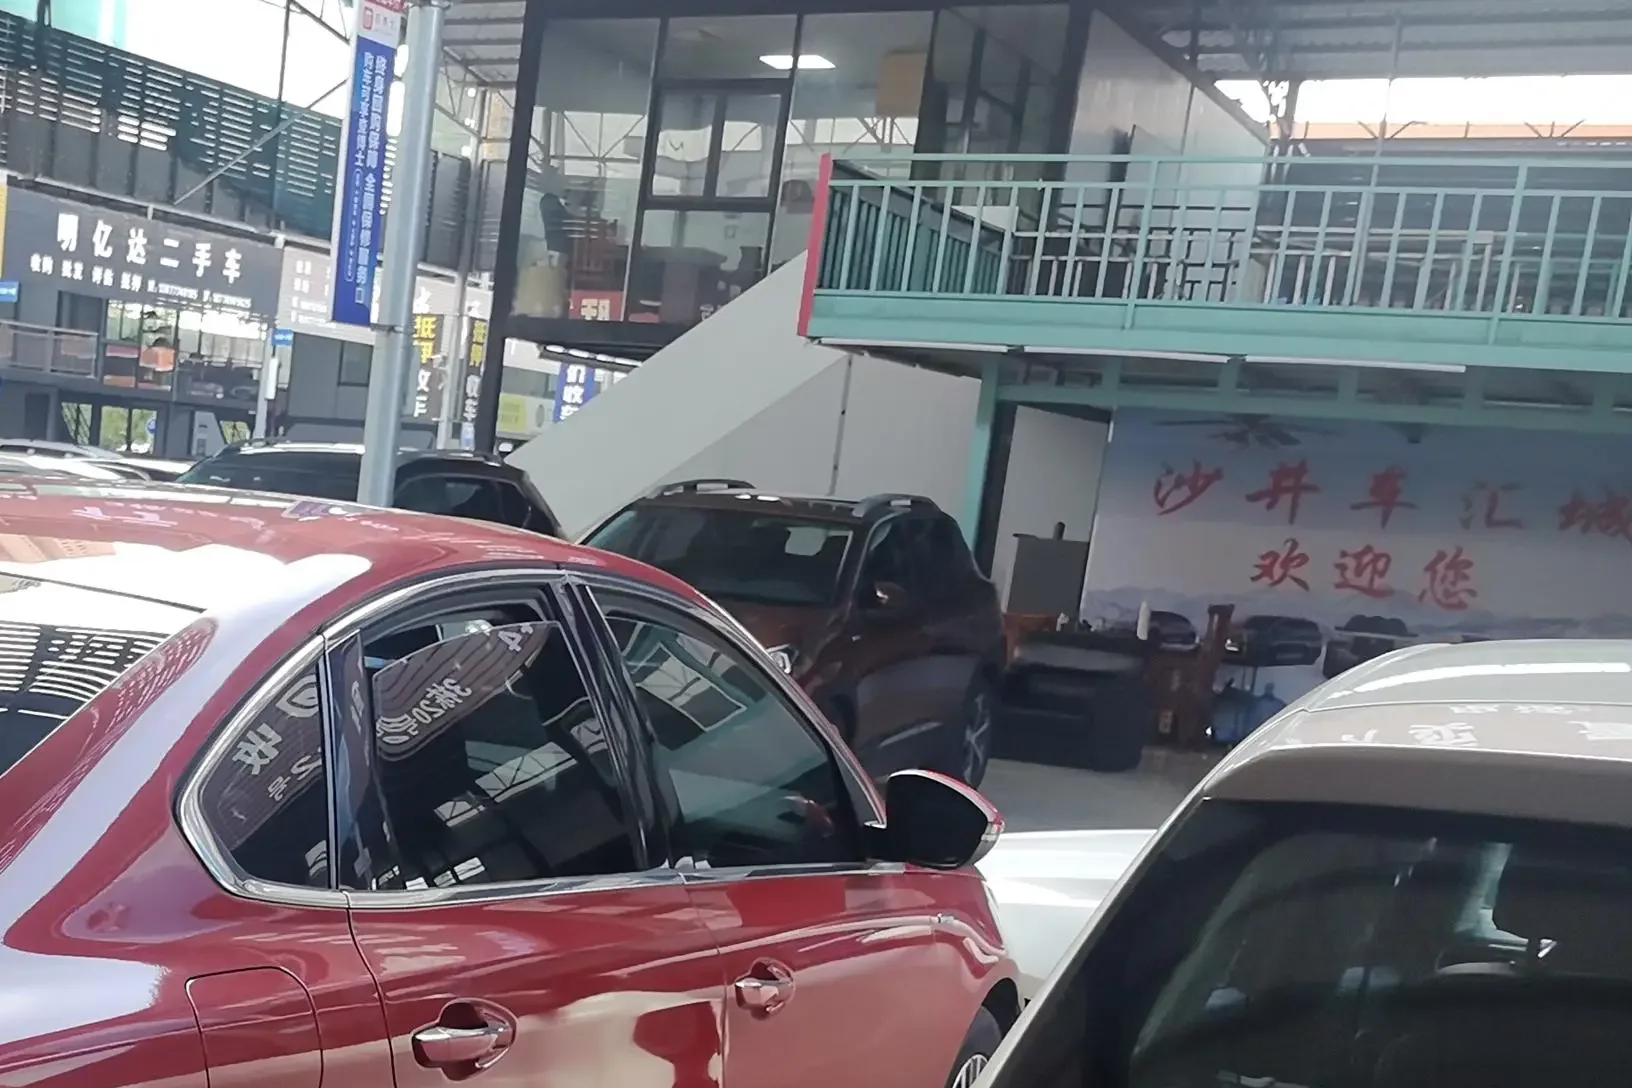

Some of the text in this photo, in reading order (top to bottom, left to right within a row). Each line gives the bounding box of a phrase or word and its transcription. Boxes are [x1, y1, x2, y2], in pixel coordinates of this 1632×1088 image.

[1153, 458, 1632, 543] 沙井车汇城
[1250, 538, 1478, 612] 欢迎您
